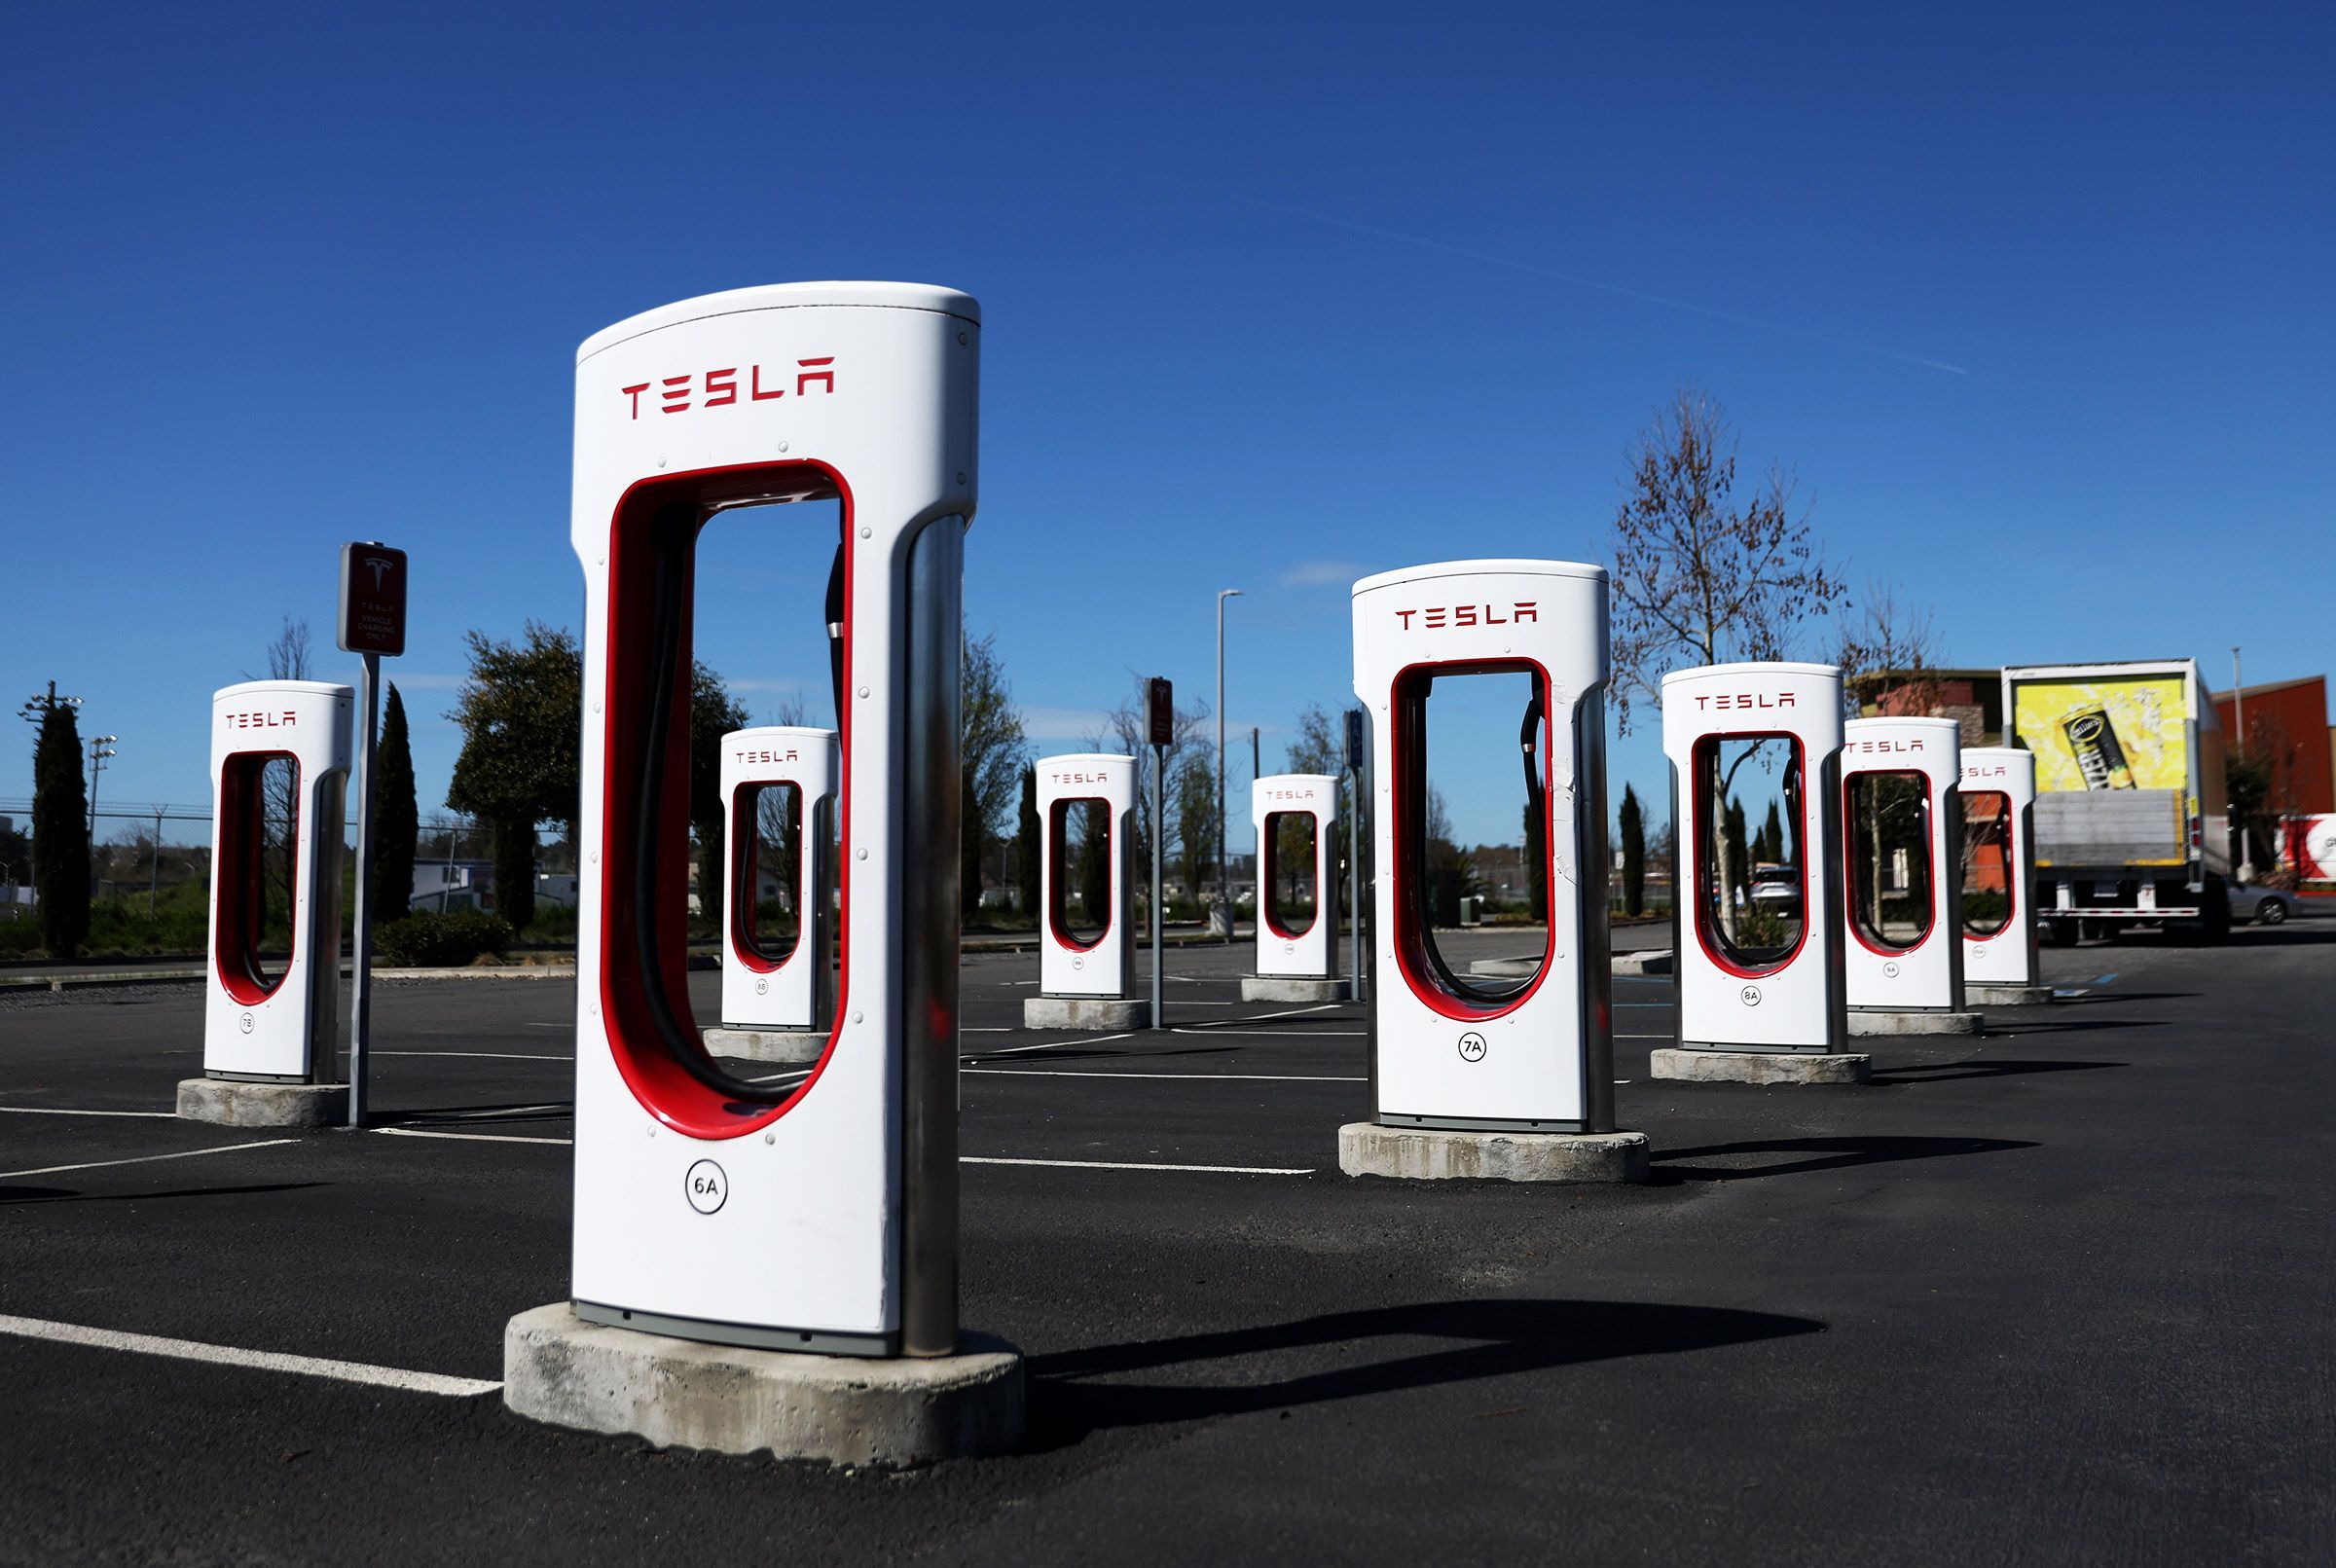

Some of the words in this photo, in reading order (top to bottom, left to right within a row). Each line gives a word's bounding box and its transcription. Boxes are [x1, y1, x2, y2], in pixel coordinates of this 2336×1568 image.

[621, 356, 835, 420] TESLA
[361, 615, 392, 626] VEHICLE
[1395, 602, 1537, 631] TESLA
[357, 623, 396, 635] CHARGING
[365, 632, 386, 640] ONLY
[1695, 692, 1795, 711] TESLA
[226, 711, 296, 729] TESLA
[1844, 740, 1923, 753] TESLA
[736, 749, 797, 764] TESLA
[1960, 766, 2006, 777] SLA
[1051, 773, 1108, 784] TESLA
[1265, 789, 1314, 800] TESLA
[1744, 991, 1758, 1000] 8A
[1464, 1040, 1482, 1052] 7A
[694, 1177, 718, 1195] 6A
